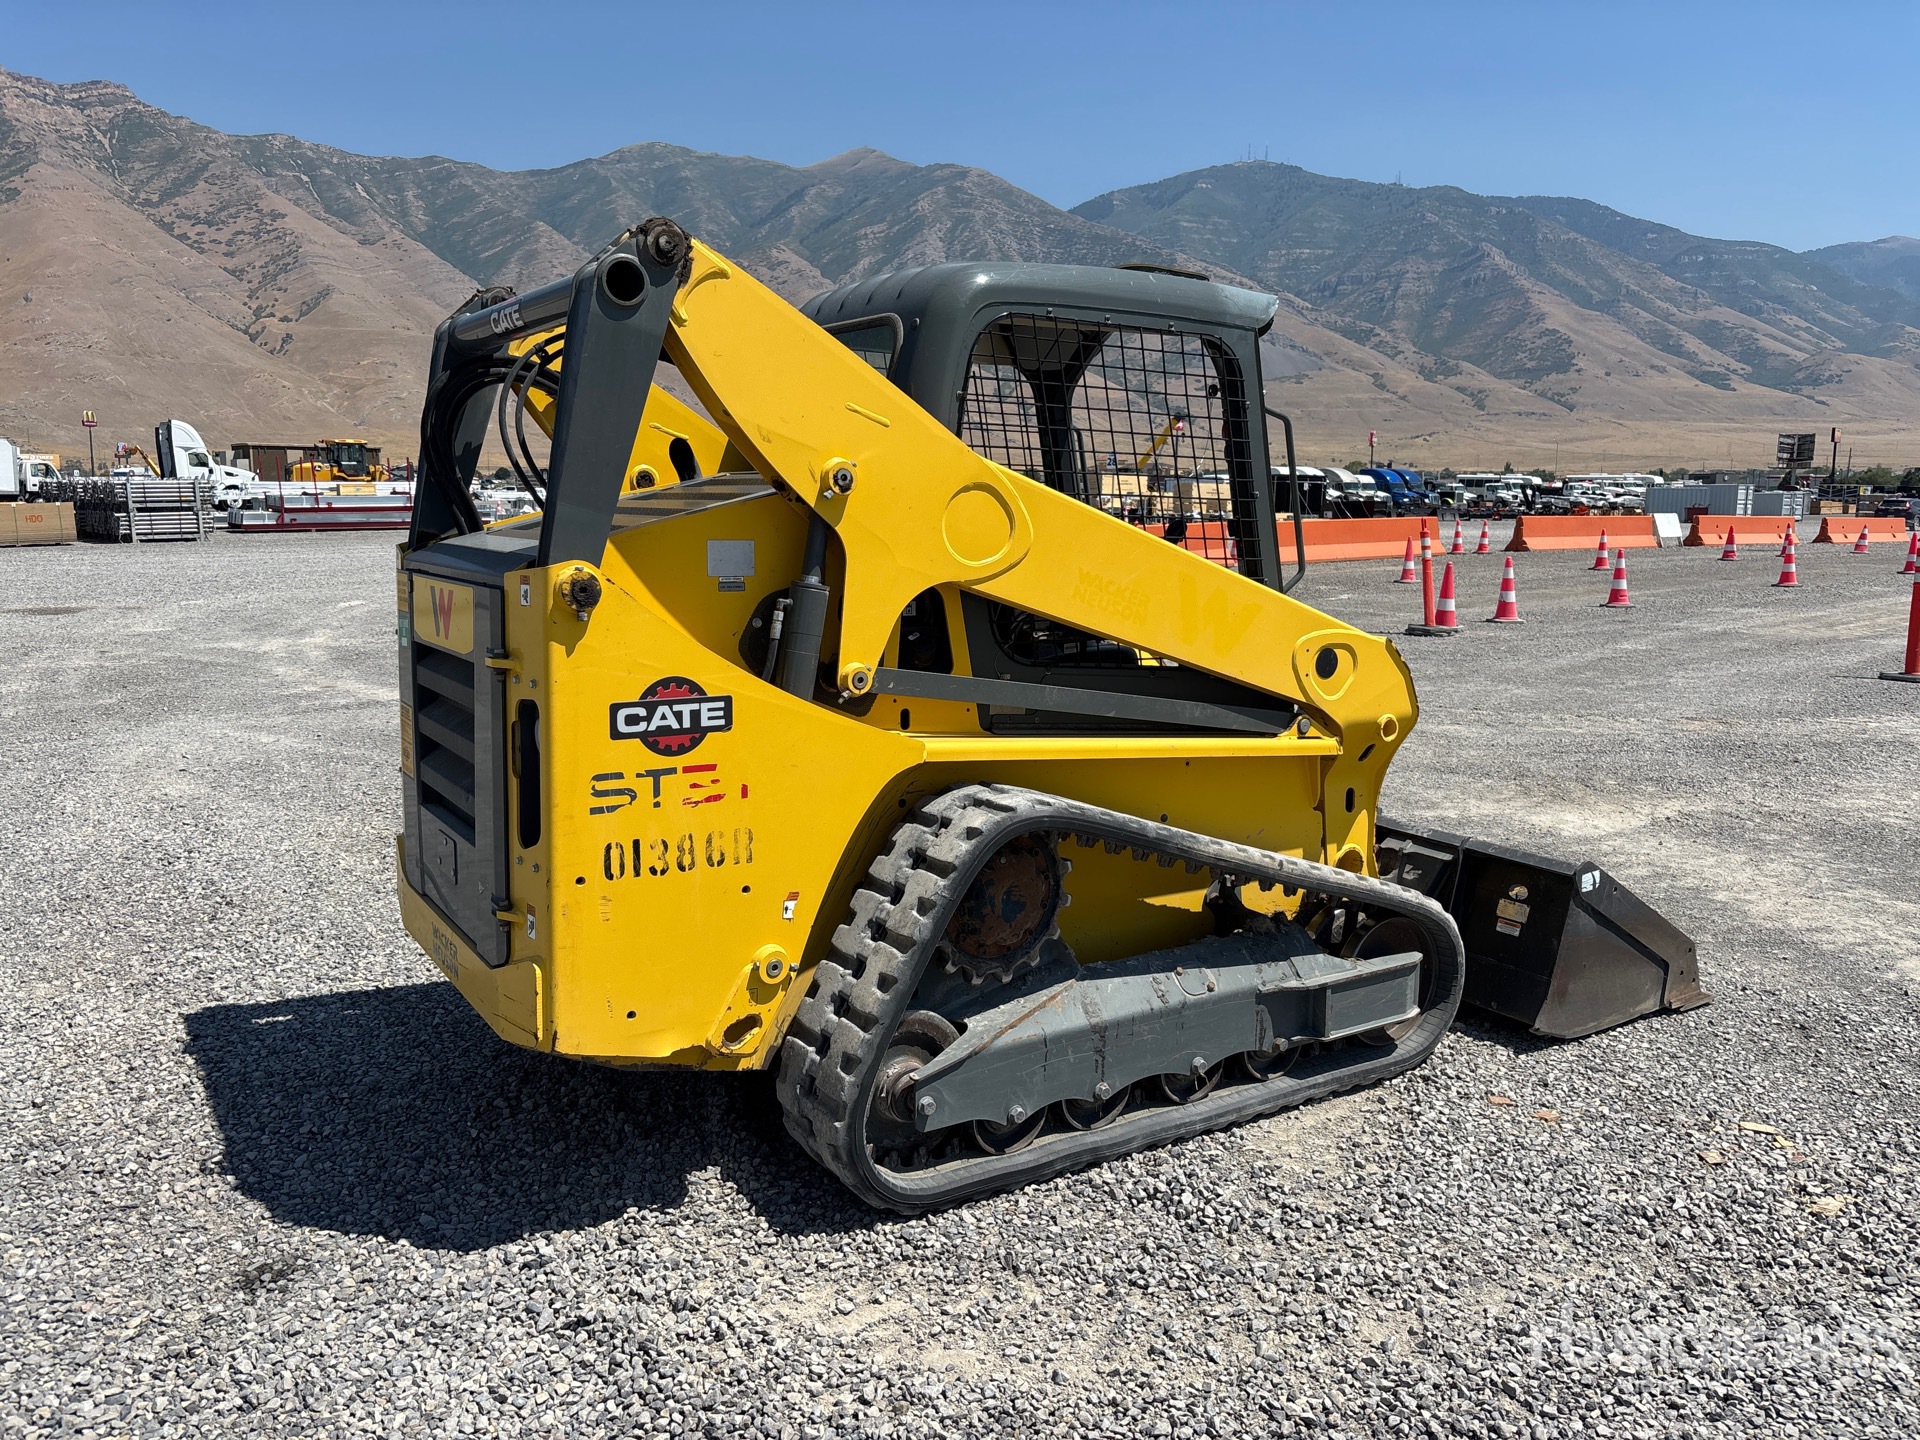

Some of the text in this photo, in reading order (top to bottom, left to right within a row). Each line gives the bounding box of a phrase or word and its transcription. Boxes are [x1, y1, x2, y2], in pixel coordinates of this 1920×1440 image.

[490, 303, 525, 334] CATE
[25, 514, 43, 523] HDO
[616, 701, 726, 734] CATE
